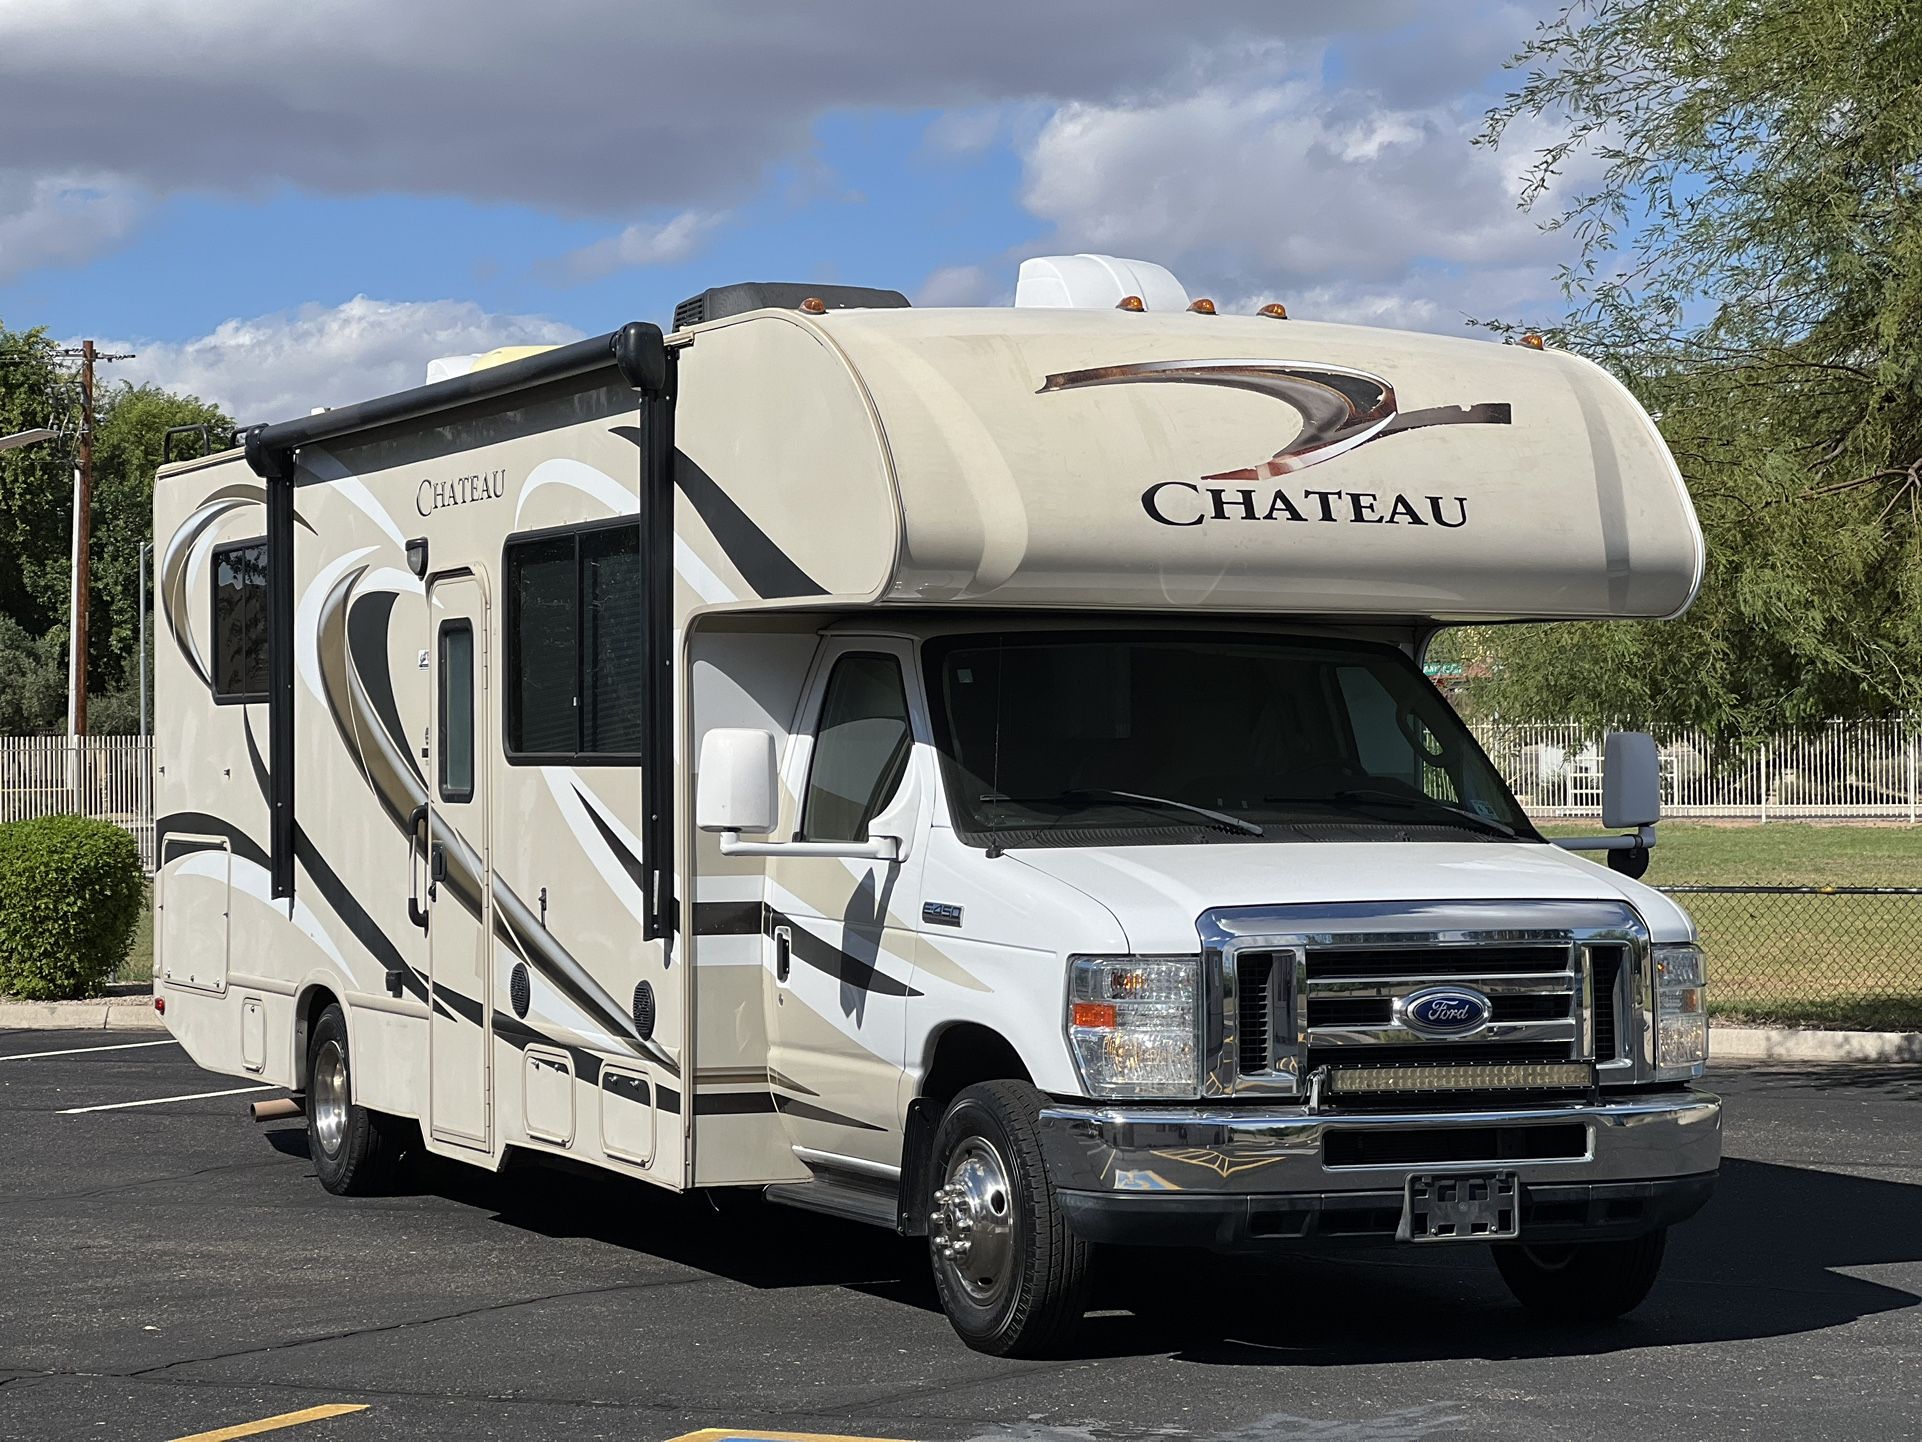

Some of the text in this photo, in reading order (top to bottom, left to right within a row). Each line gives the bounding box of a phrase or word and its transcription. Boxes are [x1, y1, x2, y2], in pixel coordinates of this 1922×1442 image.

[416, 469, 506, 517] CHATEAU
[1141, 481, 1468, 528] CHATEAU
[1428, 999, 1469, 1020] Ford
